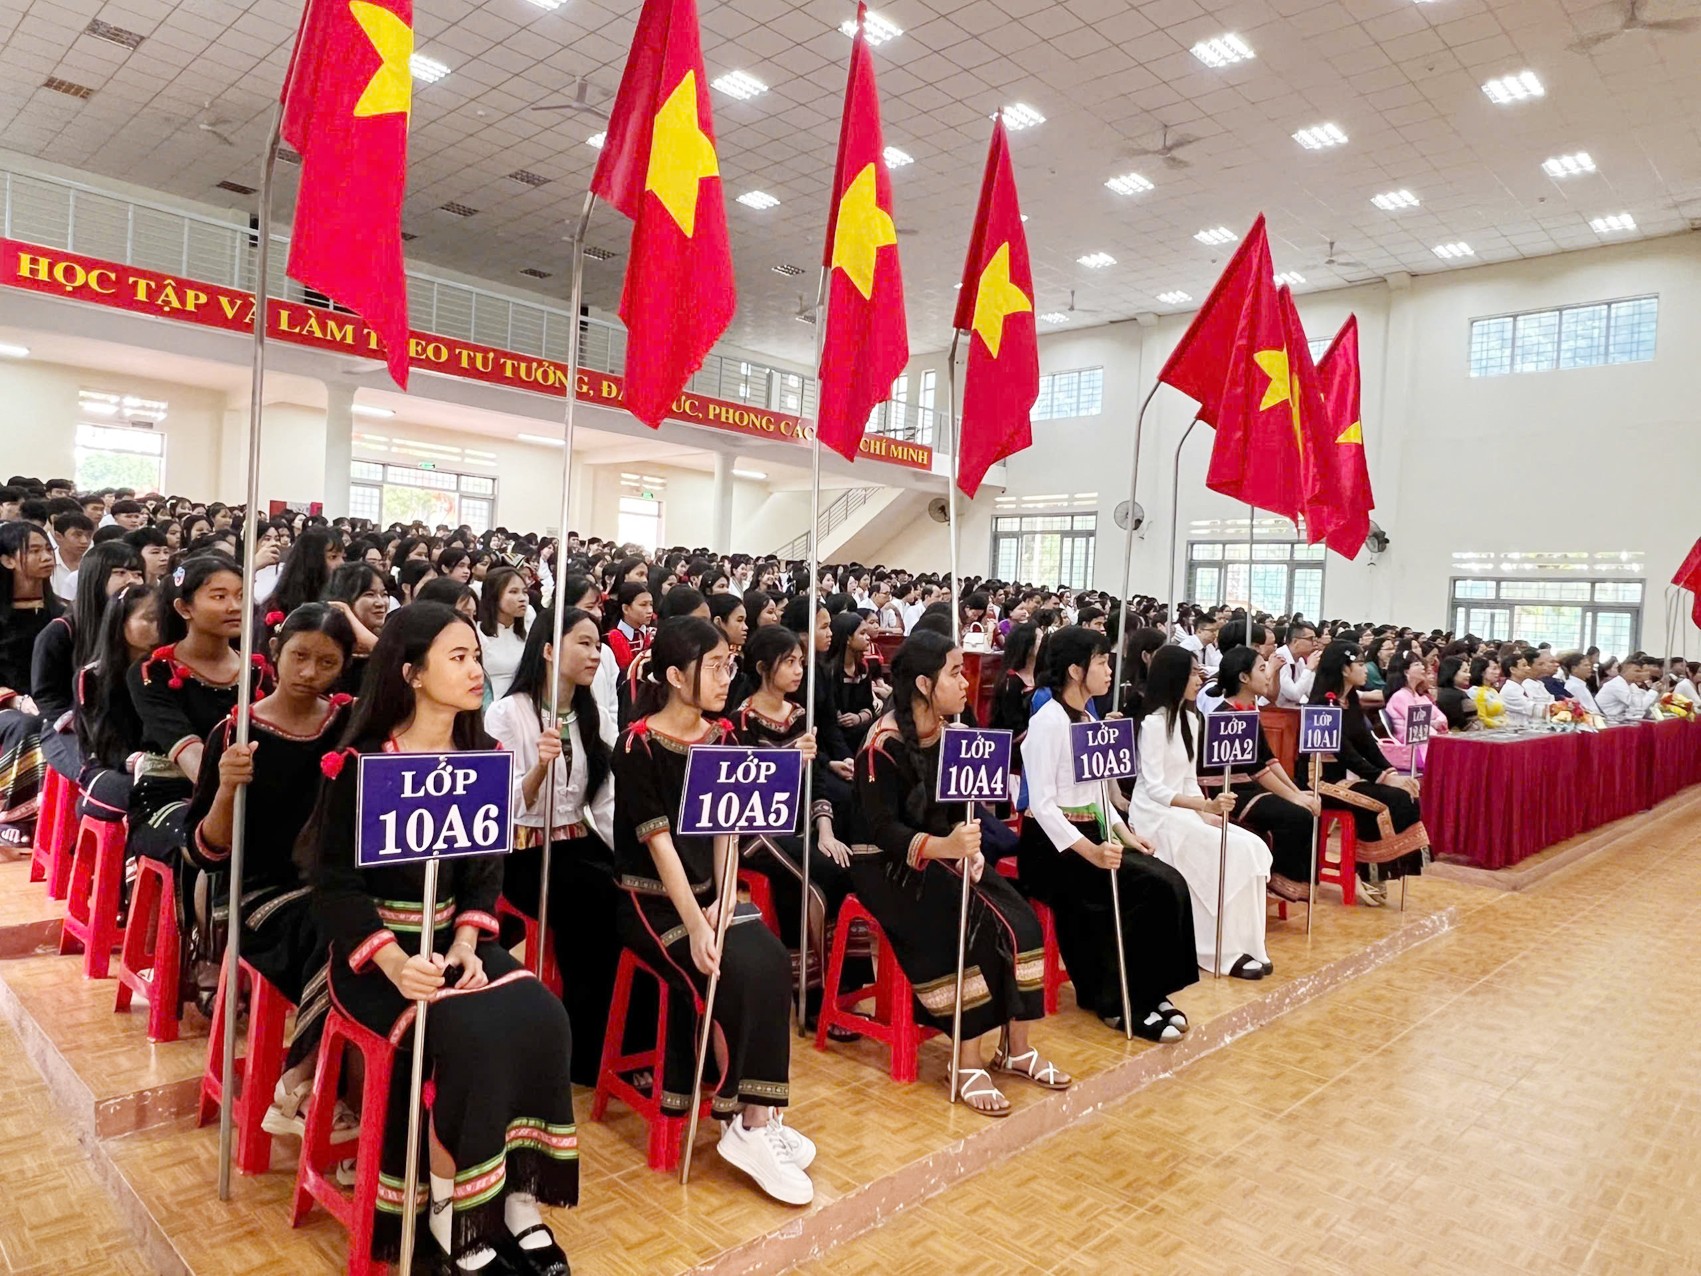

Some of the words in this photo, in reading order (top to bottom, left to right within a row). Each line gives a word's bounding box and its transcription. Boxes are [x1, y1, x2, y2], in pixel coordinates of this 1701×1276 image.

[17, 252, 117, 292] HỌC
[128, 279, 208, 312] TẬP
[278, 309, 356, 345] LÀM
[363, 328, 449, 363] TEO
[455, 349, 495, 373] TƯ
[708, 404, 775, 432] PHONG
[780, 419, 816, 441] CÁC
[859, 438, 887, 456] CHÍ
[890, 444, 929, 464] MINH
[1220, 718, 1246, 735] LỚP
[1313, 712, 1333, 726] LỚP
[960, 735, 995, 758] LỚP
[1087, 724, 1120, 746] LỚP
[1306, 729, 1337, 748] 10A1
[1080, 748, 1132, 779] 10A3
[1211, 738, 1253, 762] 10A2
[401, 762, 478, 798] LỚP
[717, 755, 777, 783] LỚP
[947, 764, 1004, 796] 10A4
[695, 790, 791, 828] 10A5
[379, 804, 499, 855] 10A6
